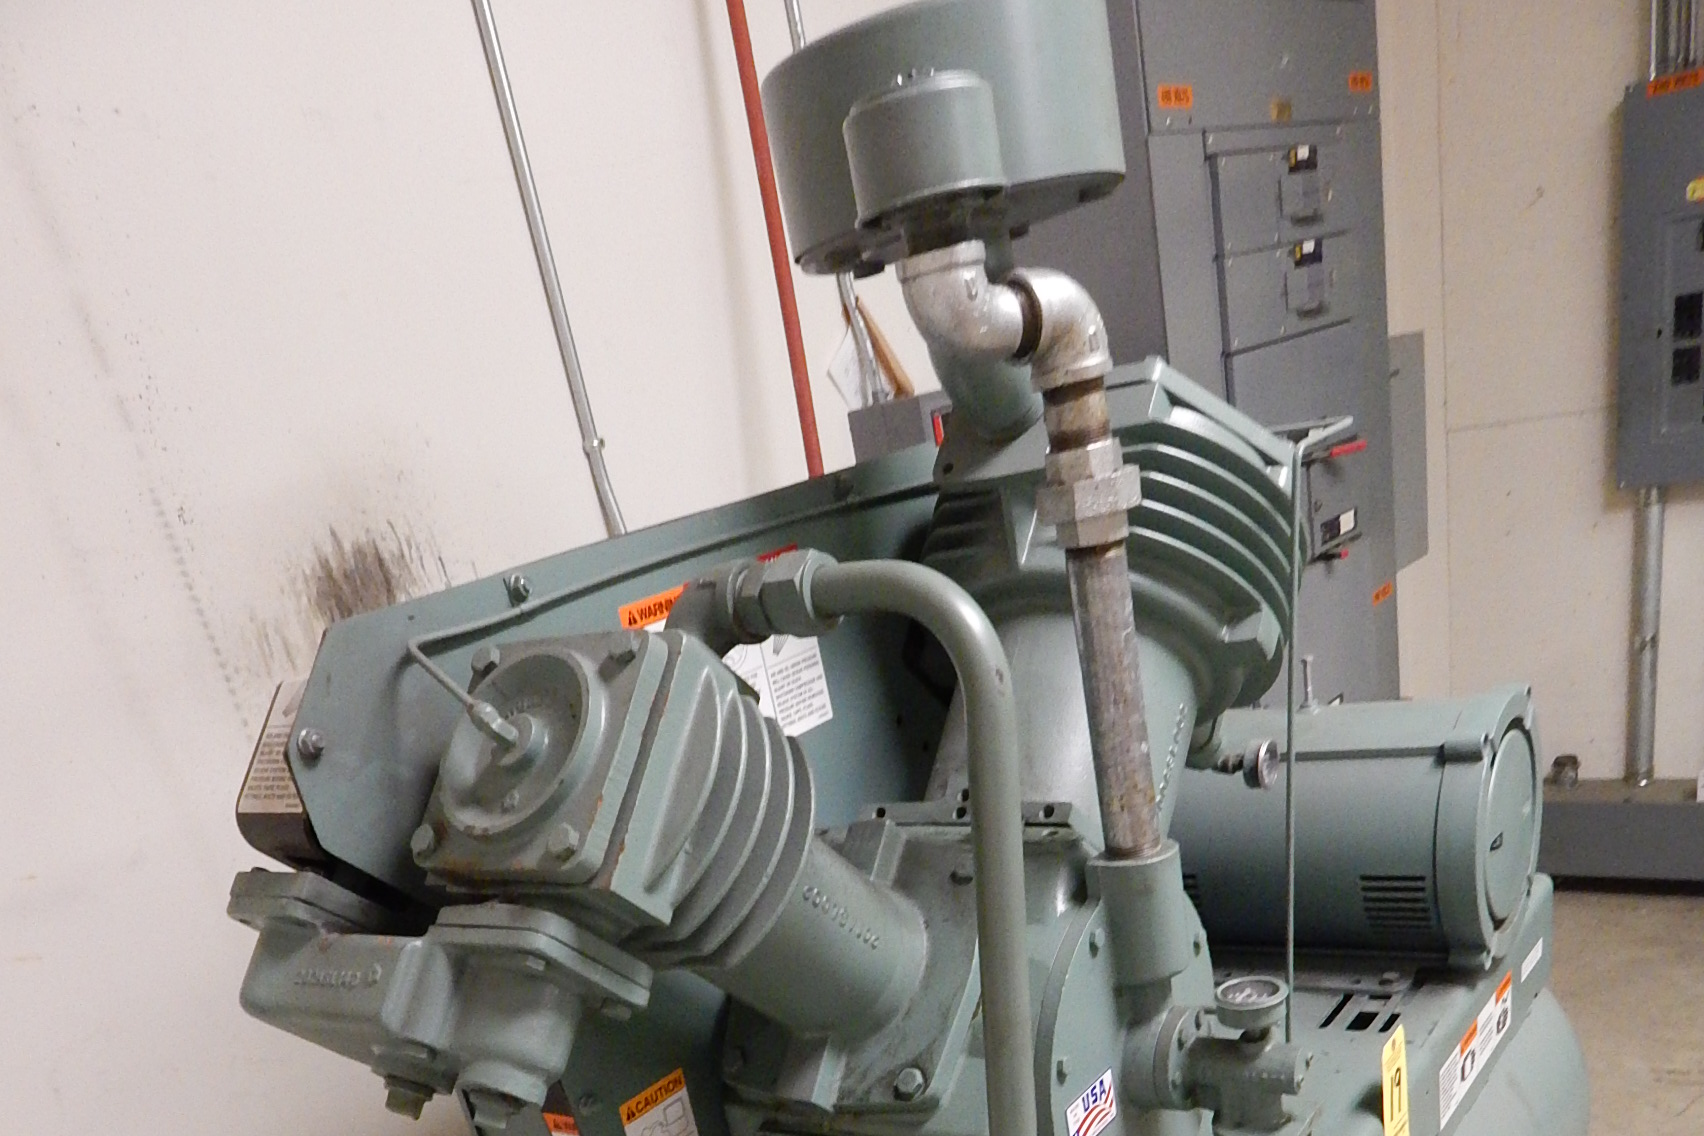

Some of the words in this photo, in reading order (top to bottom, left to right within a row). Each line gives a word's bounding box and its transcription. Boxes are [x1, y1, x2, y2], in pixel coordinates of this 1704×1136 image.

[636, 1075, 683, 1113] CAUTION
[1082, 1079, 1107, 1113] USA
[1390, 1067, 1402, 1123] 19
